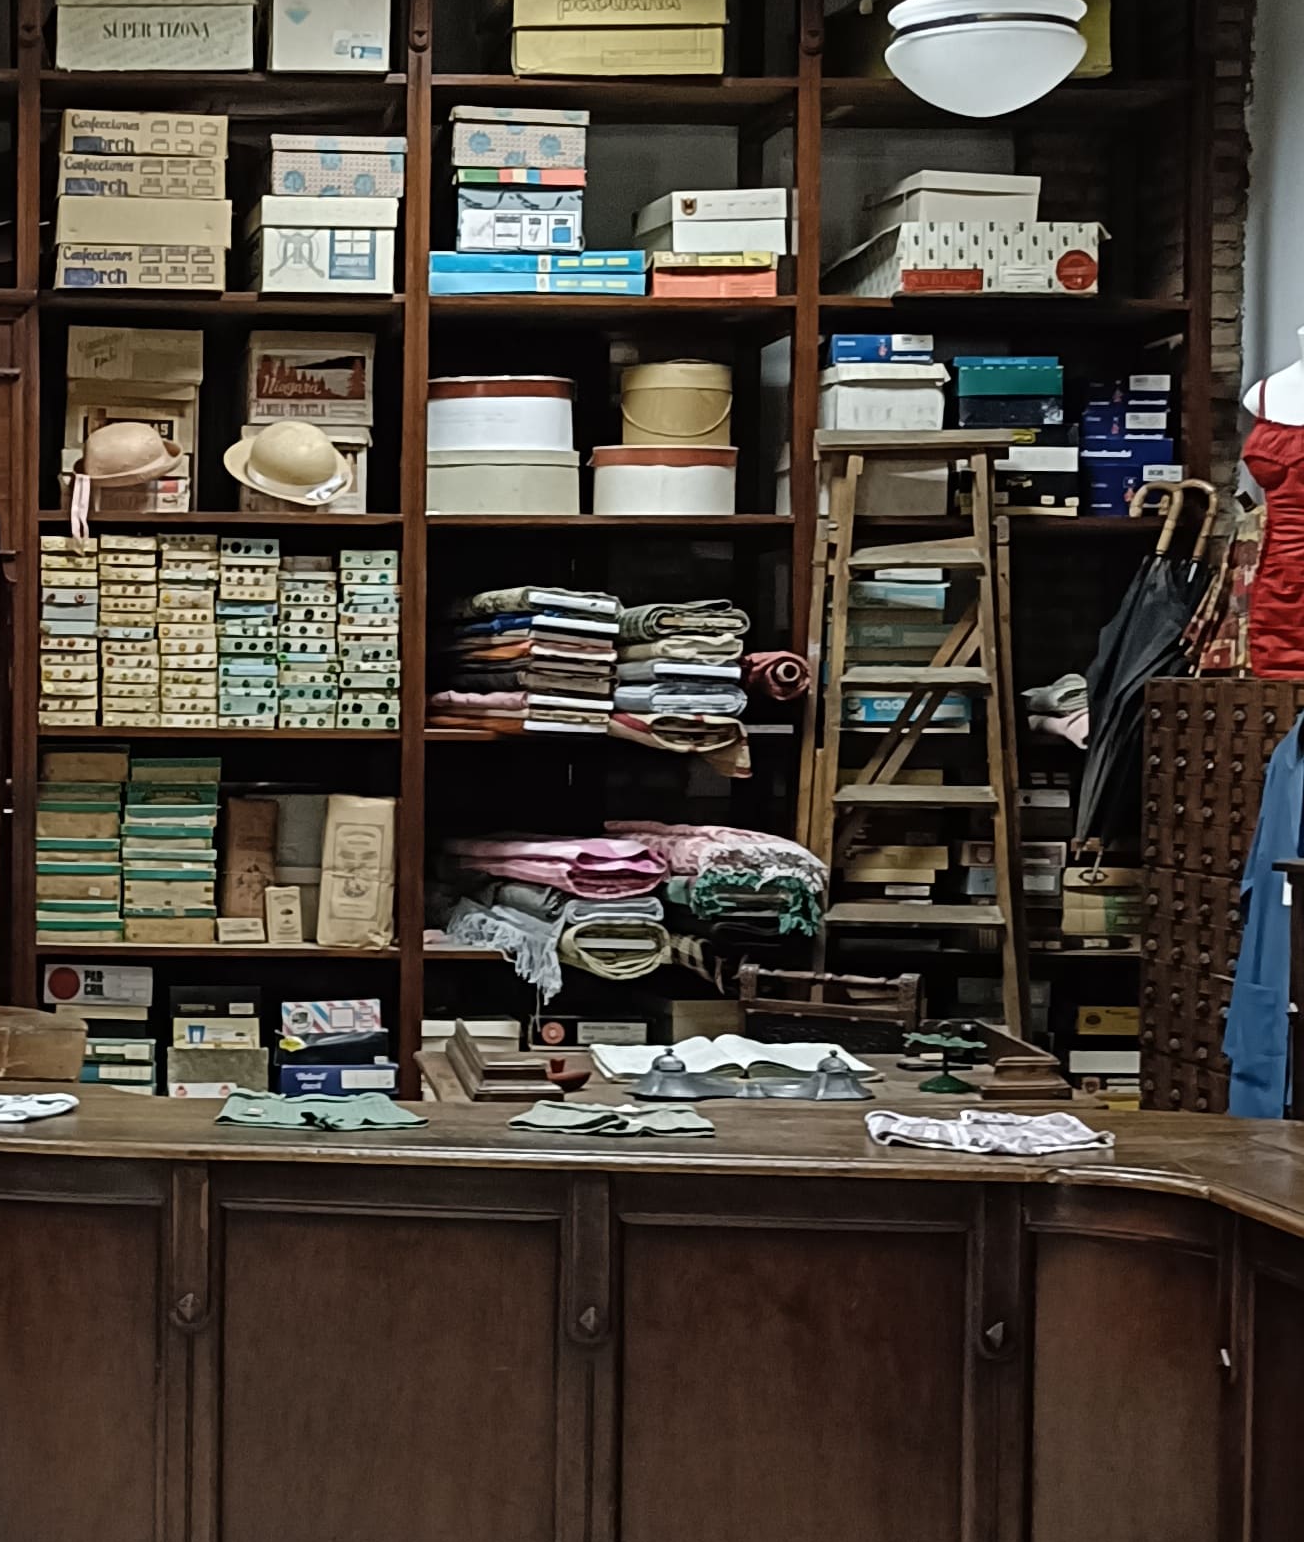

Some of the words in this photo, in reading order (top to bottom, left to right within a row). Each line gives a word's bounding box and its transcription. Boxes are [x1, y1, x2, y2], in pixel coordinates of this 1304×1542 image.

[158, 22, 209, 39] TIZONA
[71, 113, 140, 133] Confecciones
[64, 156, 134, 174] Confecciones
[62, 245, 133, 265] Confecciones
[263, 375, 322, 396] Niagara
